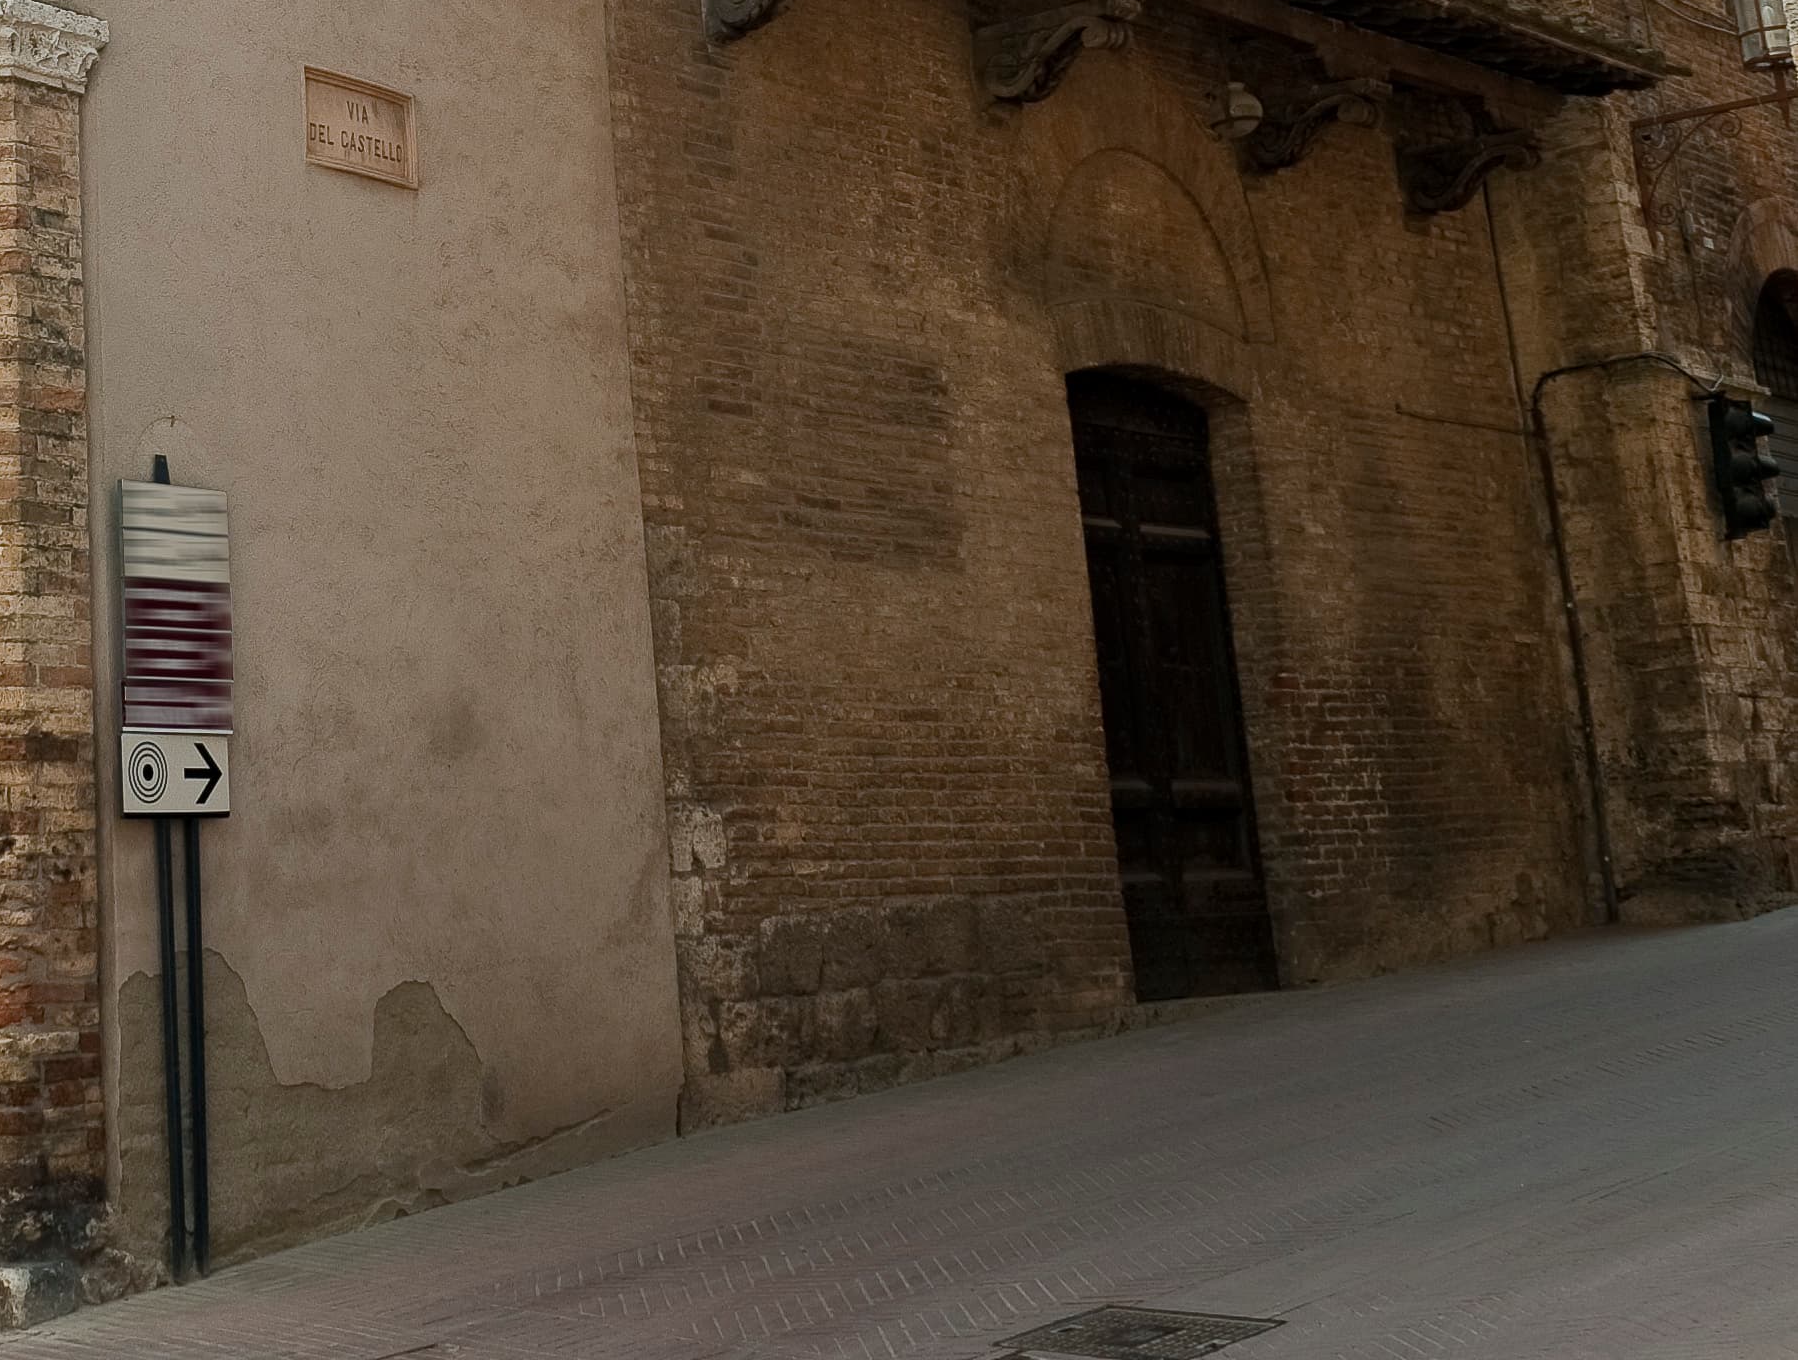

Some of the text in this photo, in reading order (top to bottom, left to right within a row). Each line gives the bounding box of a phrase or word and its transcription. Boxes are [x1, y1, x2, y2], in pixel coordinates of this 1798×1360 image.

[346, 100, 369, 125] VIA
[309, 122, 403, 163] DEL CASTELLO
